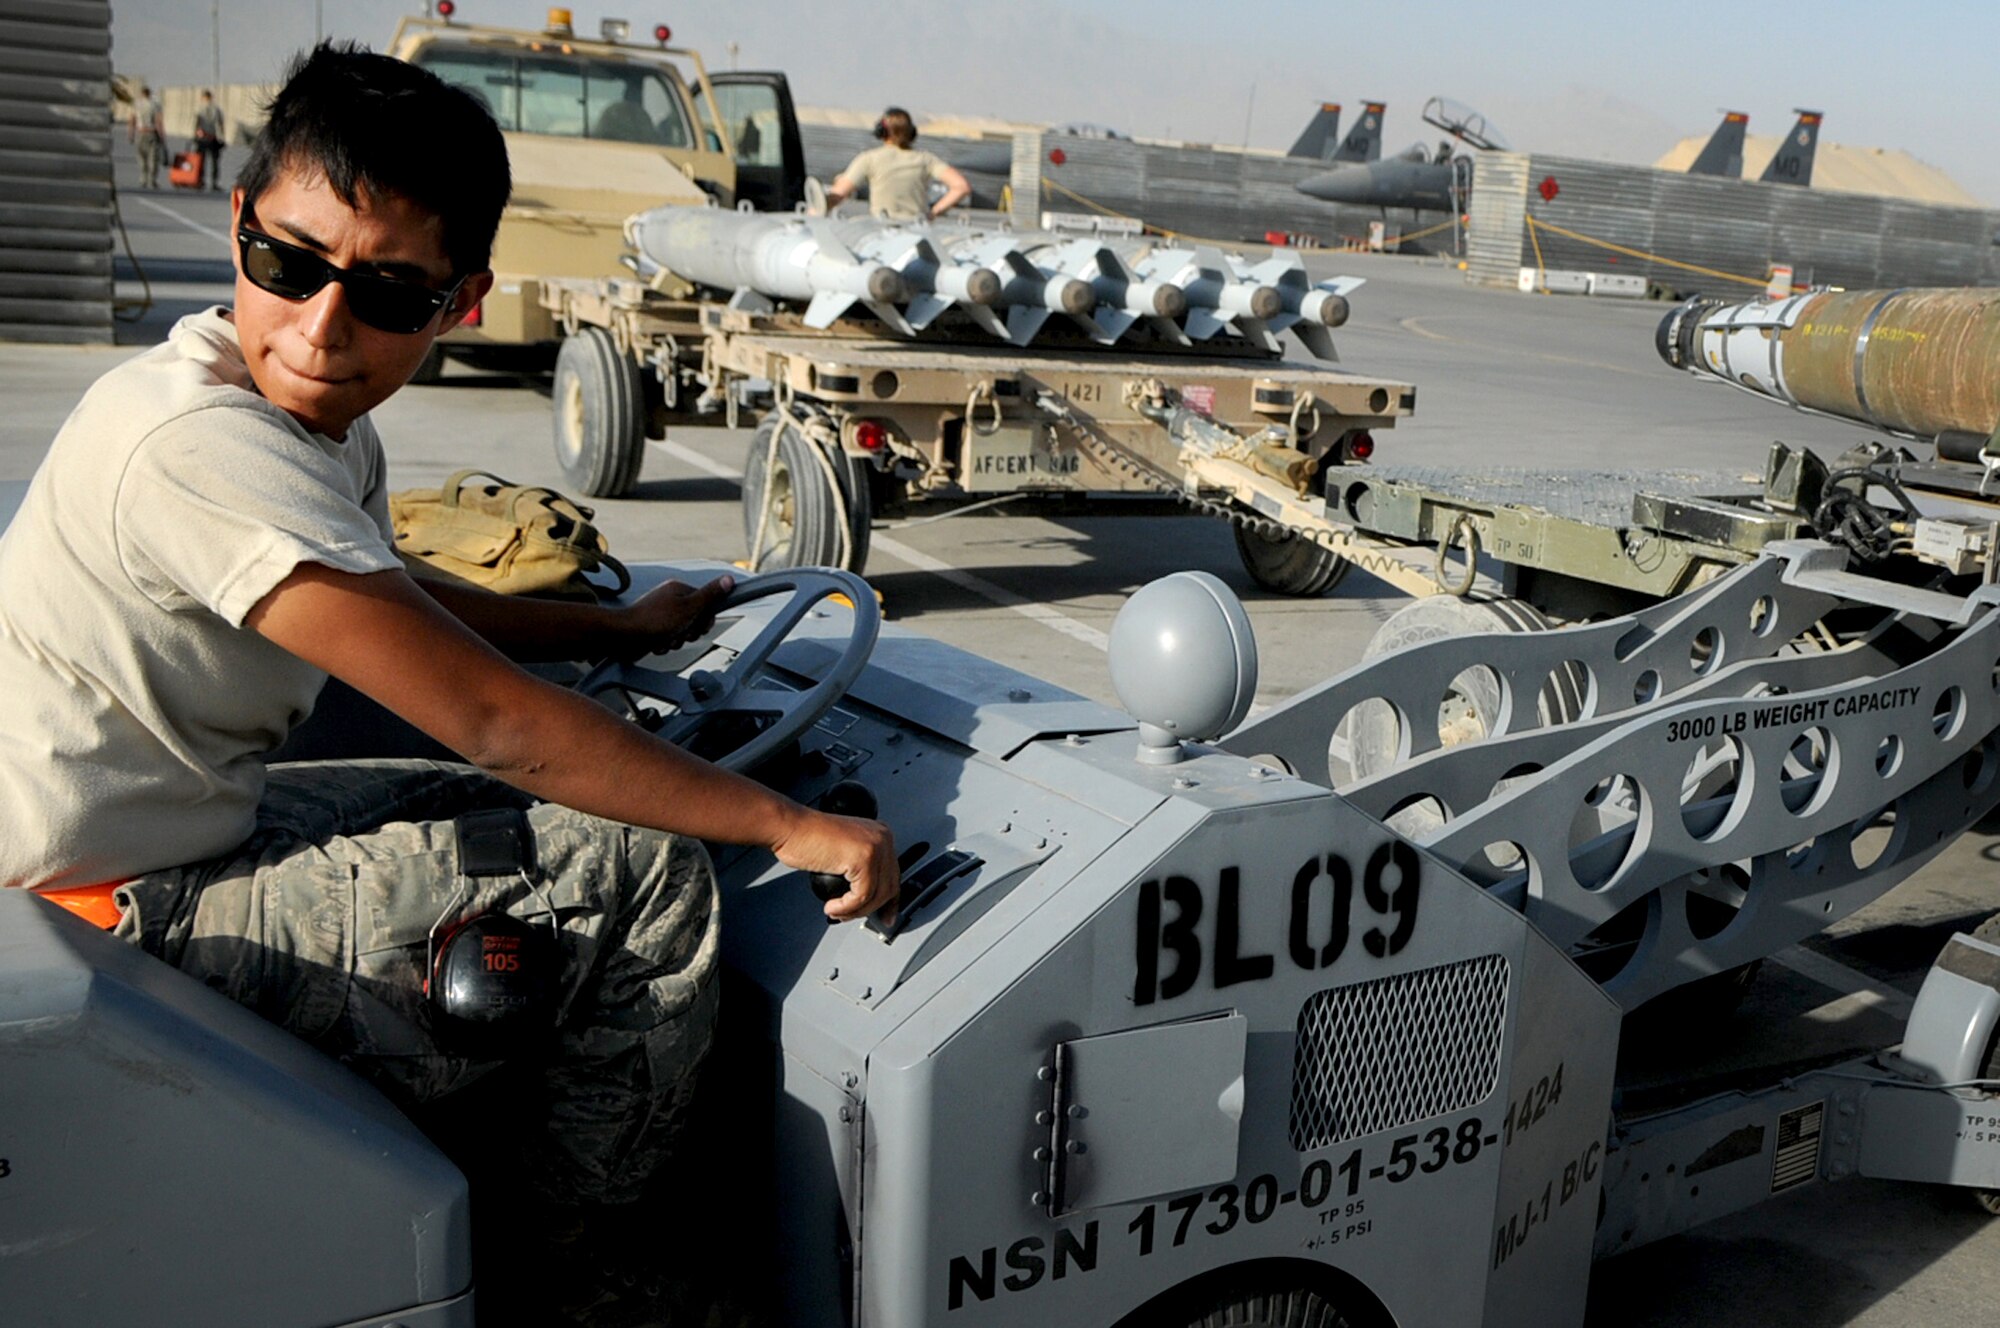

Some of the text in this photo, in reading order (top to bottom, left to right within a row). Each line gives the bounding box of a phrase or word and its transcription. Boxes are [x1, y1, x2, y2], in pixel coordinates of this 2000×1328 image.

[1063, 382, 1101, 402] 1421
[974, 455, 1036, 474] AFCENT
[1497, 537, 1534, 559] TP 50
[1666, 686, 1922, 743] 3000 LB WEIGHT CAPACITY
[1133, 839, 1421, 1007] BL09
[483, 952, 520, 971] 105
[1965, 1115, 1984, 1126] TP
[1975, 1131, 1984, 1142] 5
[1318, 1199, 1365, 1226] TP 95
[1493, 1140, 1600, 1271] MJ-1 B/C
[1307, 1219, 1372, 1250] +/- 5 PSI
[947, 1220, 1100, 1312] NSN
